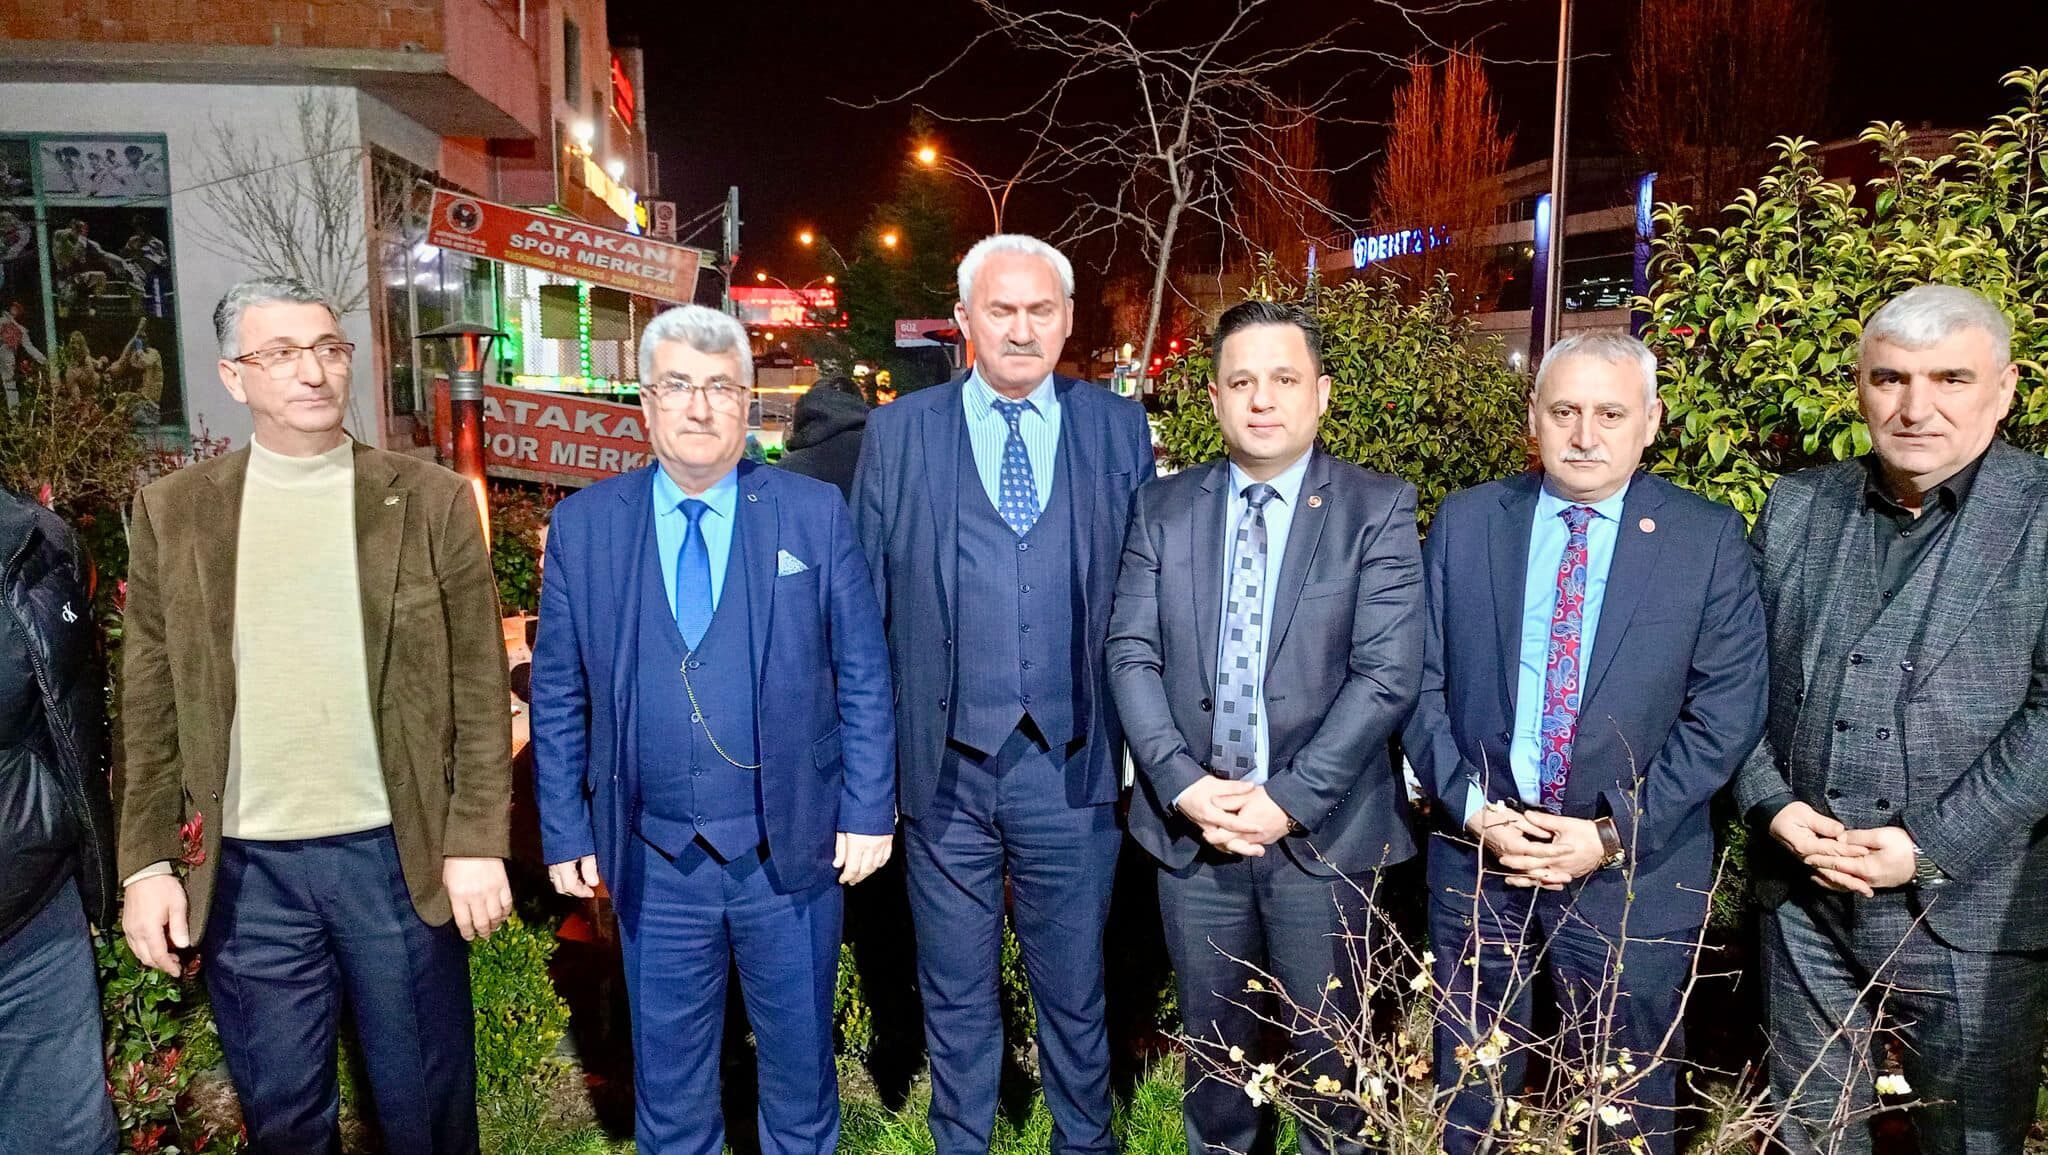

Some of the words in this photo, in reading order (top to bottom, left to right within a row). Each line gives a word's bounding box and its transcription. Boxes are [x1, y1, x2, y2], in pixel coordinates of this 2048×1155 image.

[508, 233, 572, 261] SPOR
[525, 219, 667, 263] ATAKAN
[484, 396, 646, 442] ATAKA
[549, 440, 656, 473] MERK
